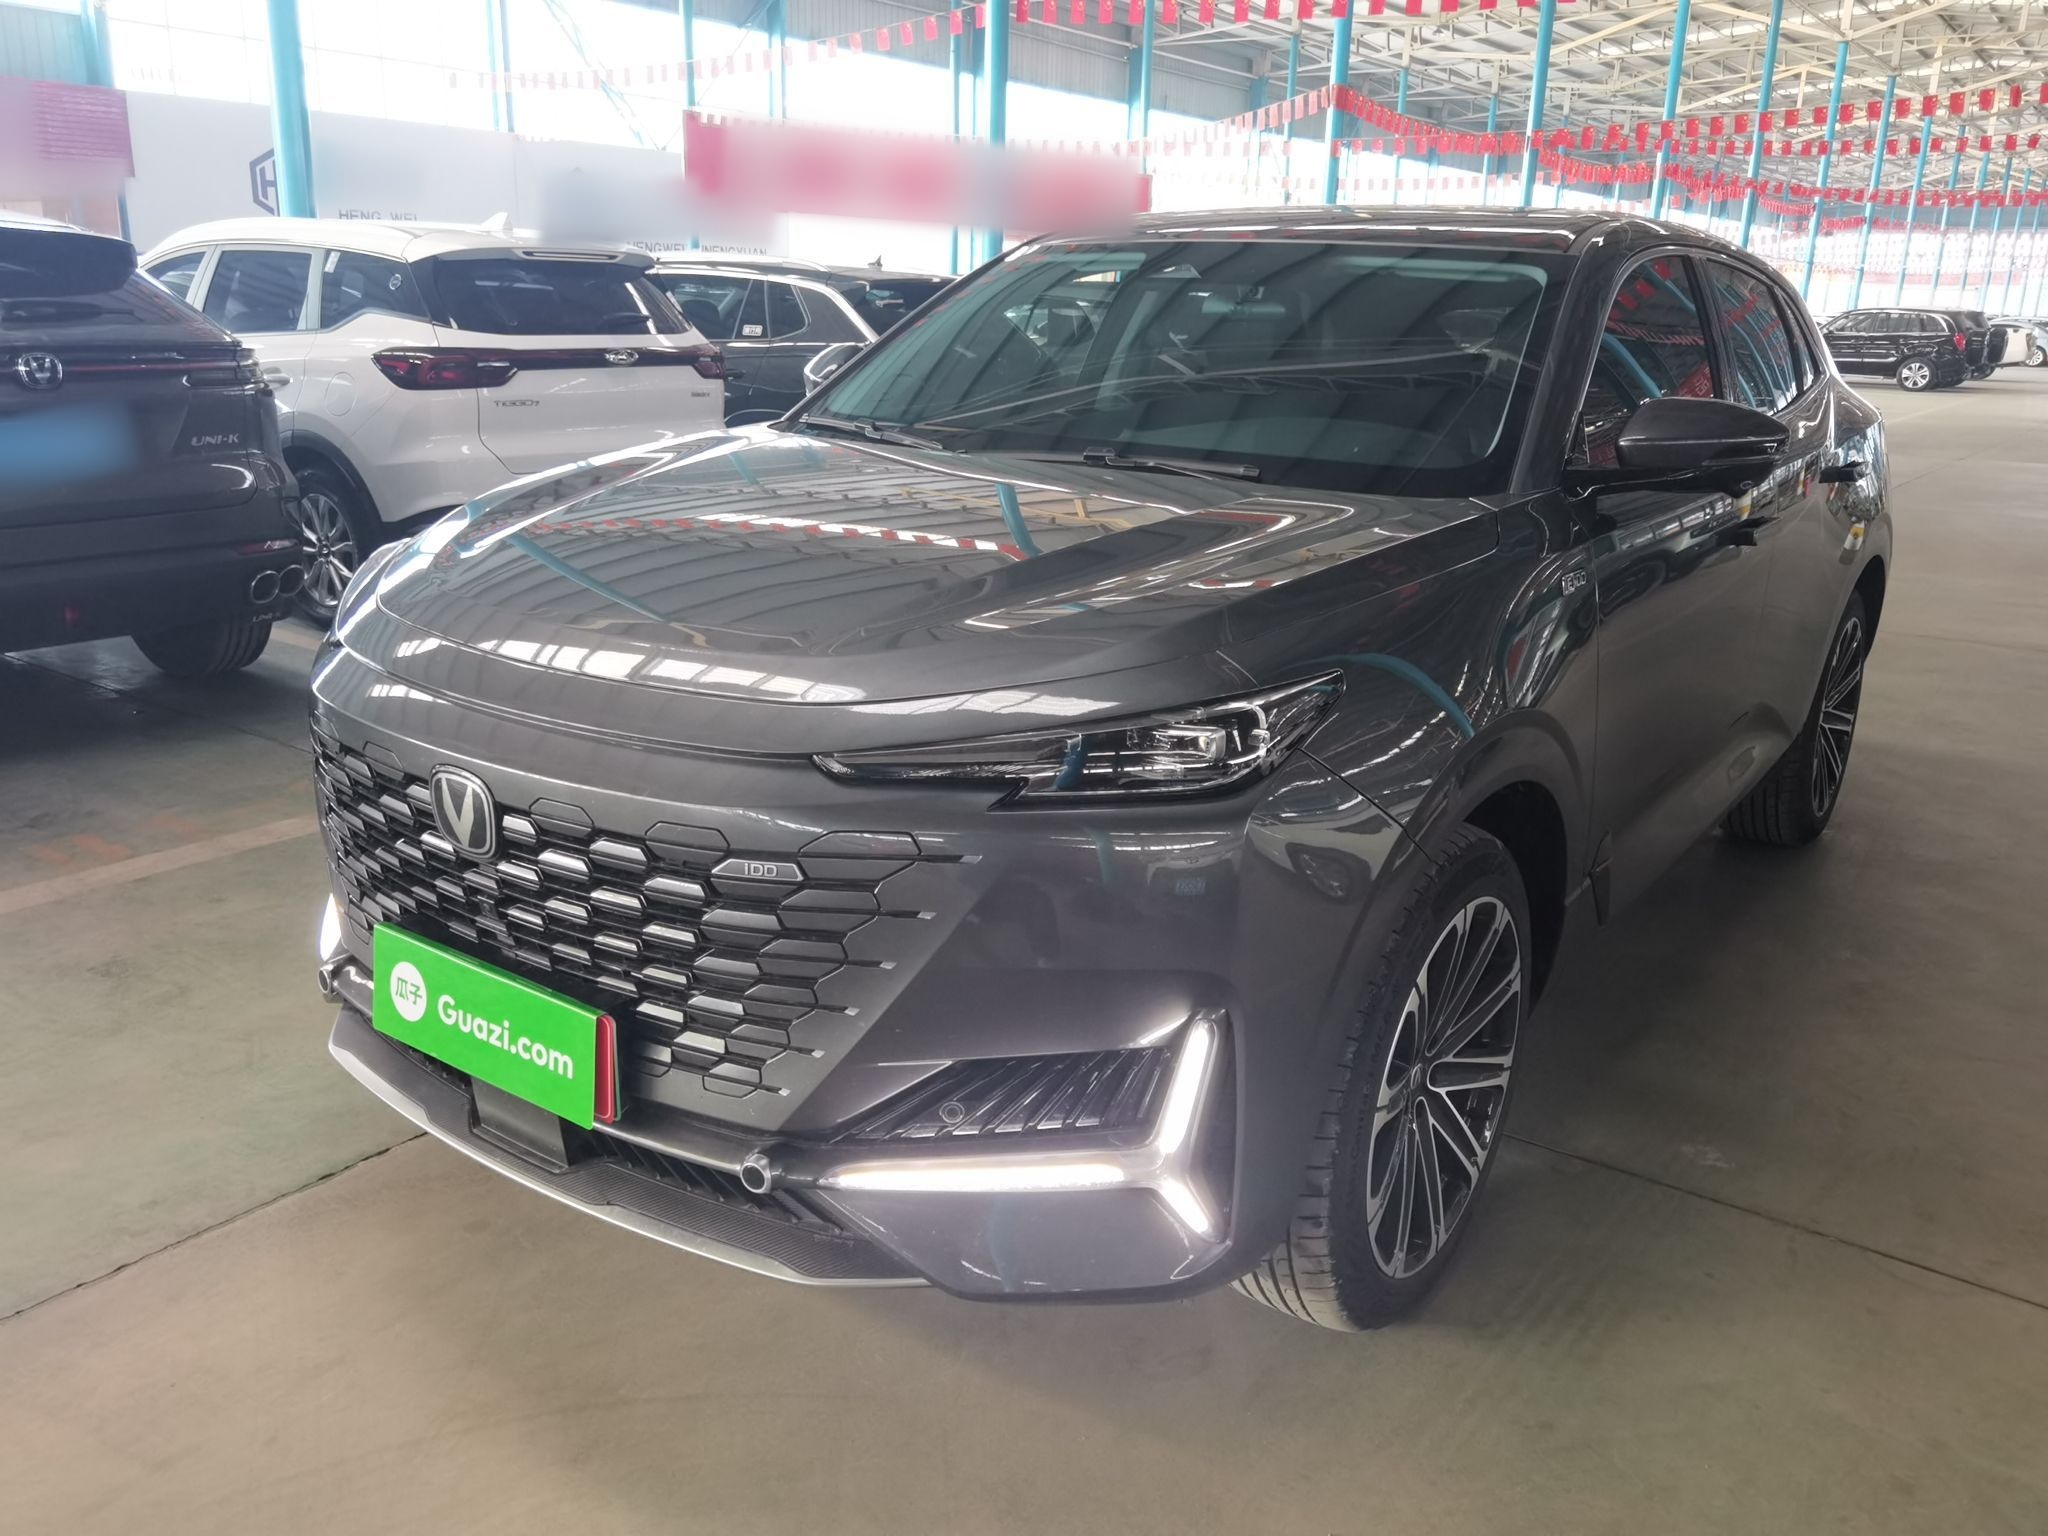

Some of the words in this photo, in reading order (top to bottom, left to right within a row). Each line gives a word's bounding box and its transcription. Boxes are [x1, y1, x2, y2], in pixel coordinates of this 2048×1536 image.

[191, 432, 239, 446] UNI-K
[395, 976, 423, 1006] 瓜子
[437, 994, 574, 1080] Guazi.com
